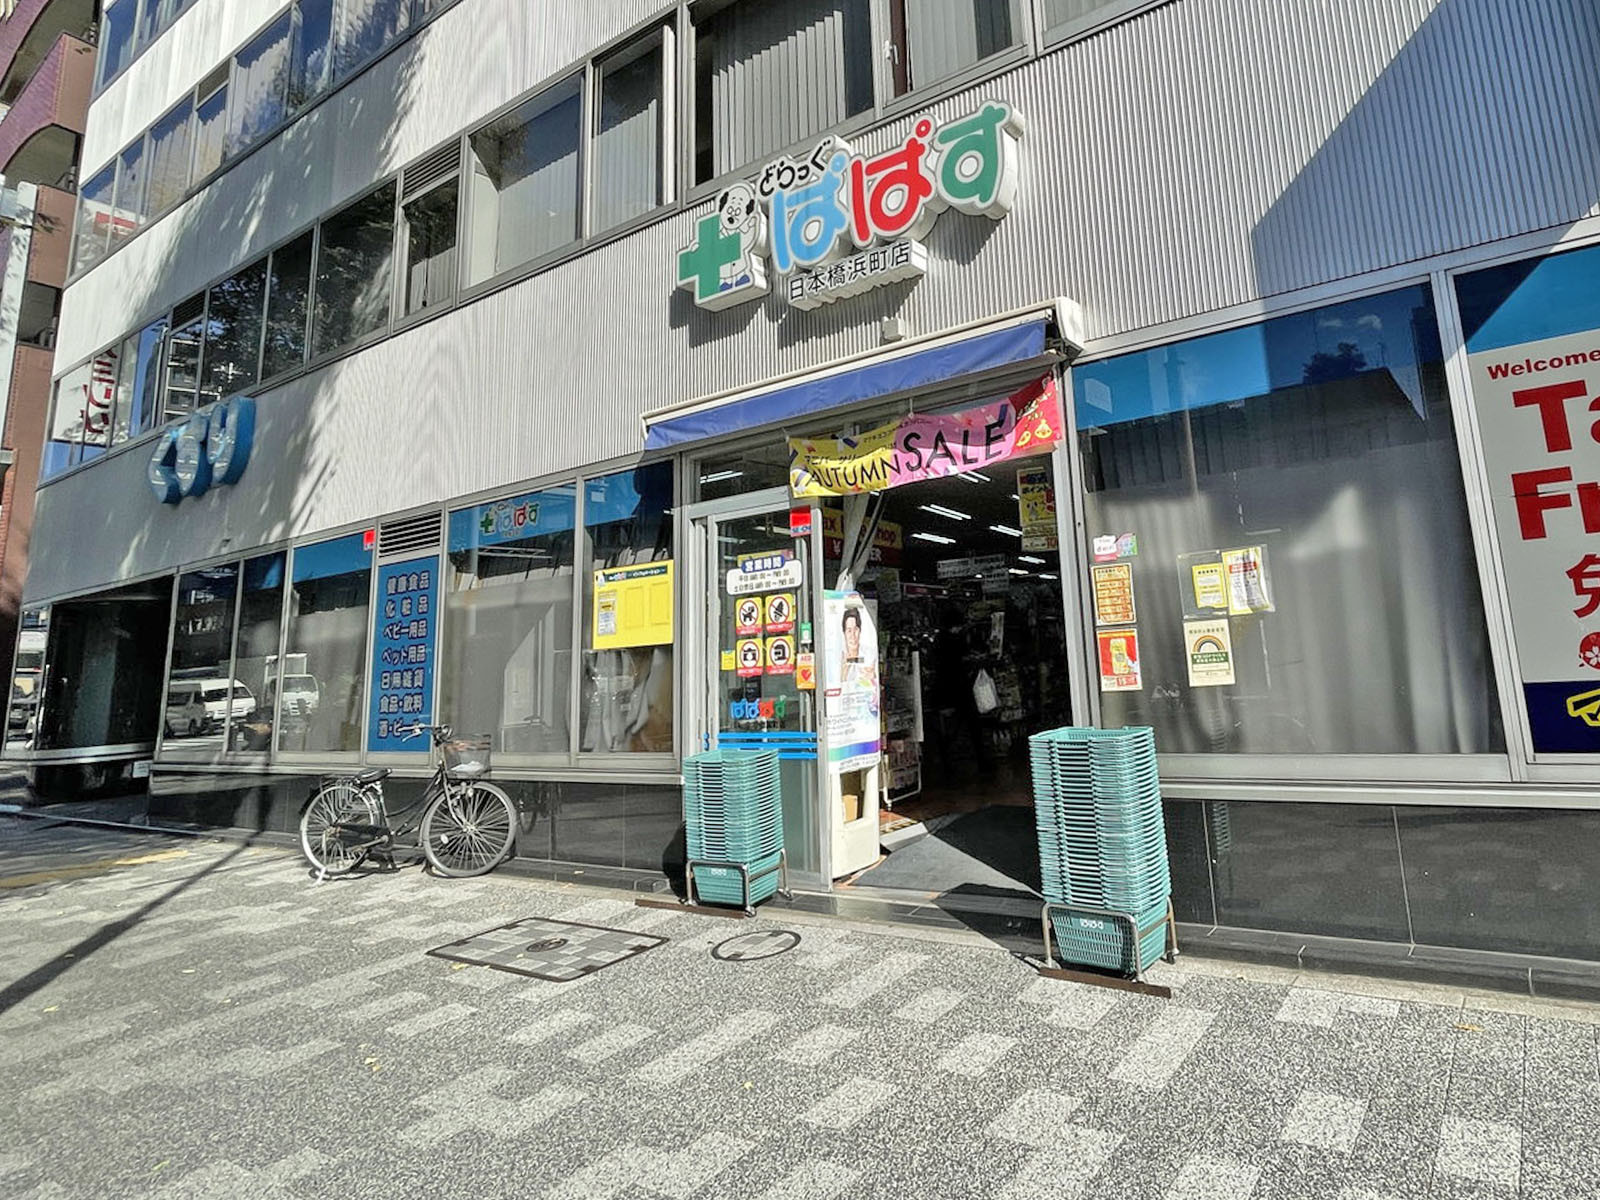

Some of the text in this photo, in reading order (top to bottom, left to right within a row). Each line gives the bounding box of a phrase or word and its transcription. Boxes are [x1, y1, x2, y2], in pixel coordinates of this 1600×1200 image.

[759, 139, 833, 196] どらっぐ
[772, 104, 1008, 271] ぱぱす
[790, 243, 910, 300] 日本橋浜町店
[1512, 380, 1600, 453] T
[805, 453, 899, 488] AUTUMN
[903, 418, 1006, 471] SALE
[382, 644, 426, 665] ペット用品
[383, 619, 427, 640] ベビー用品
